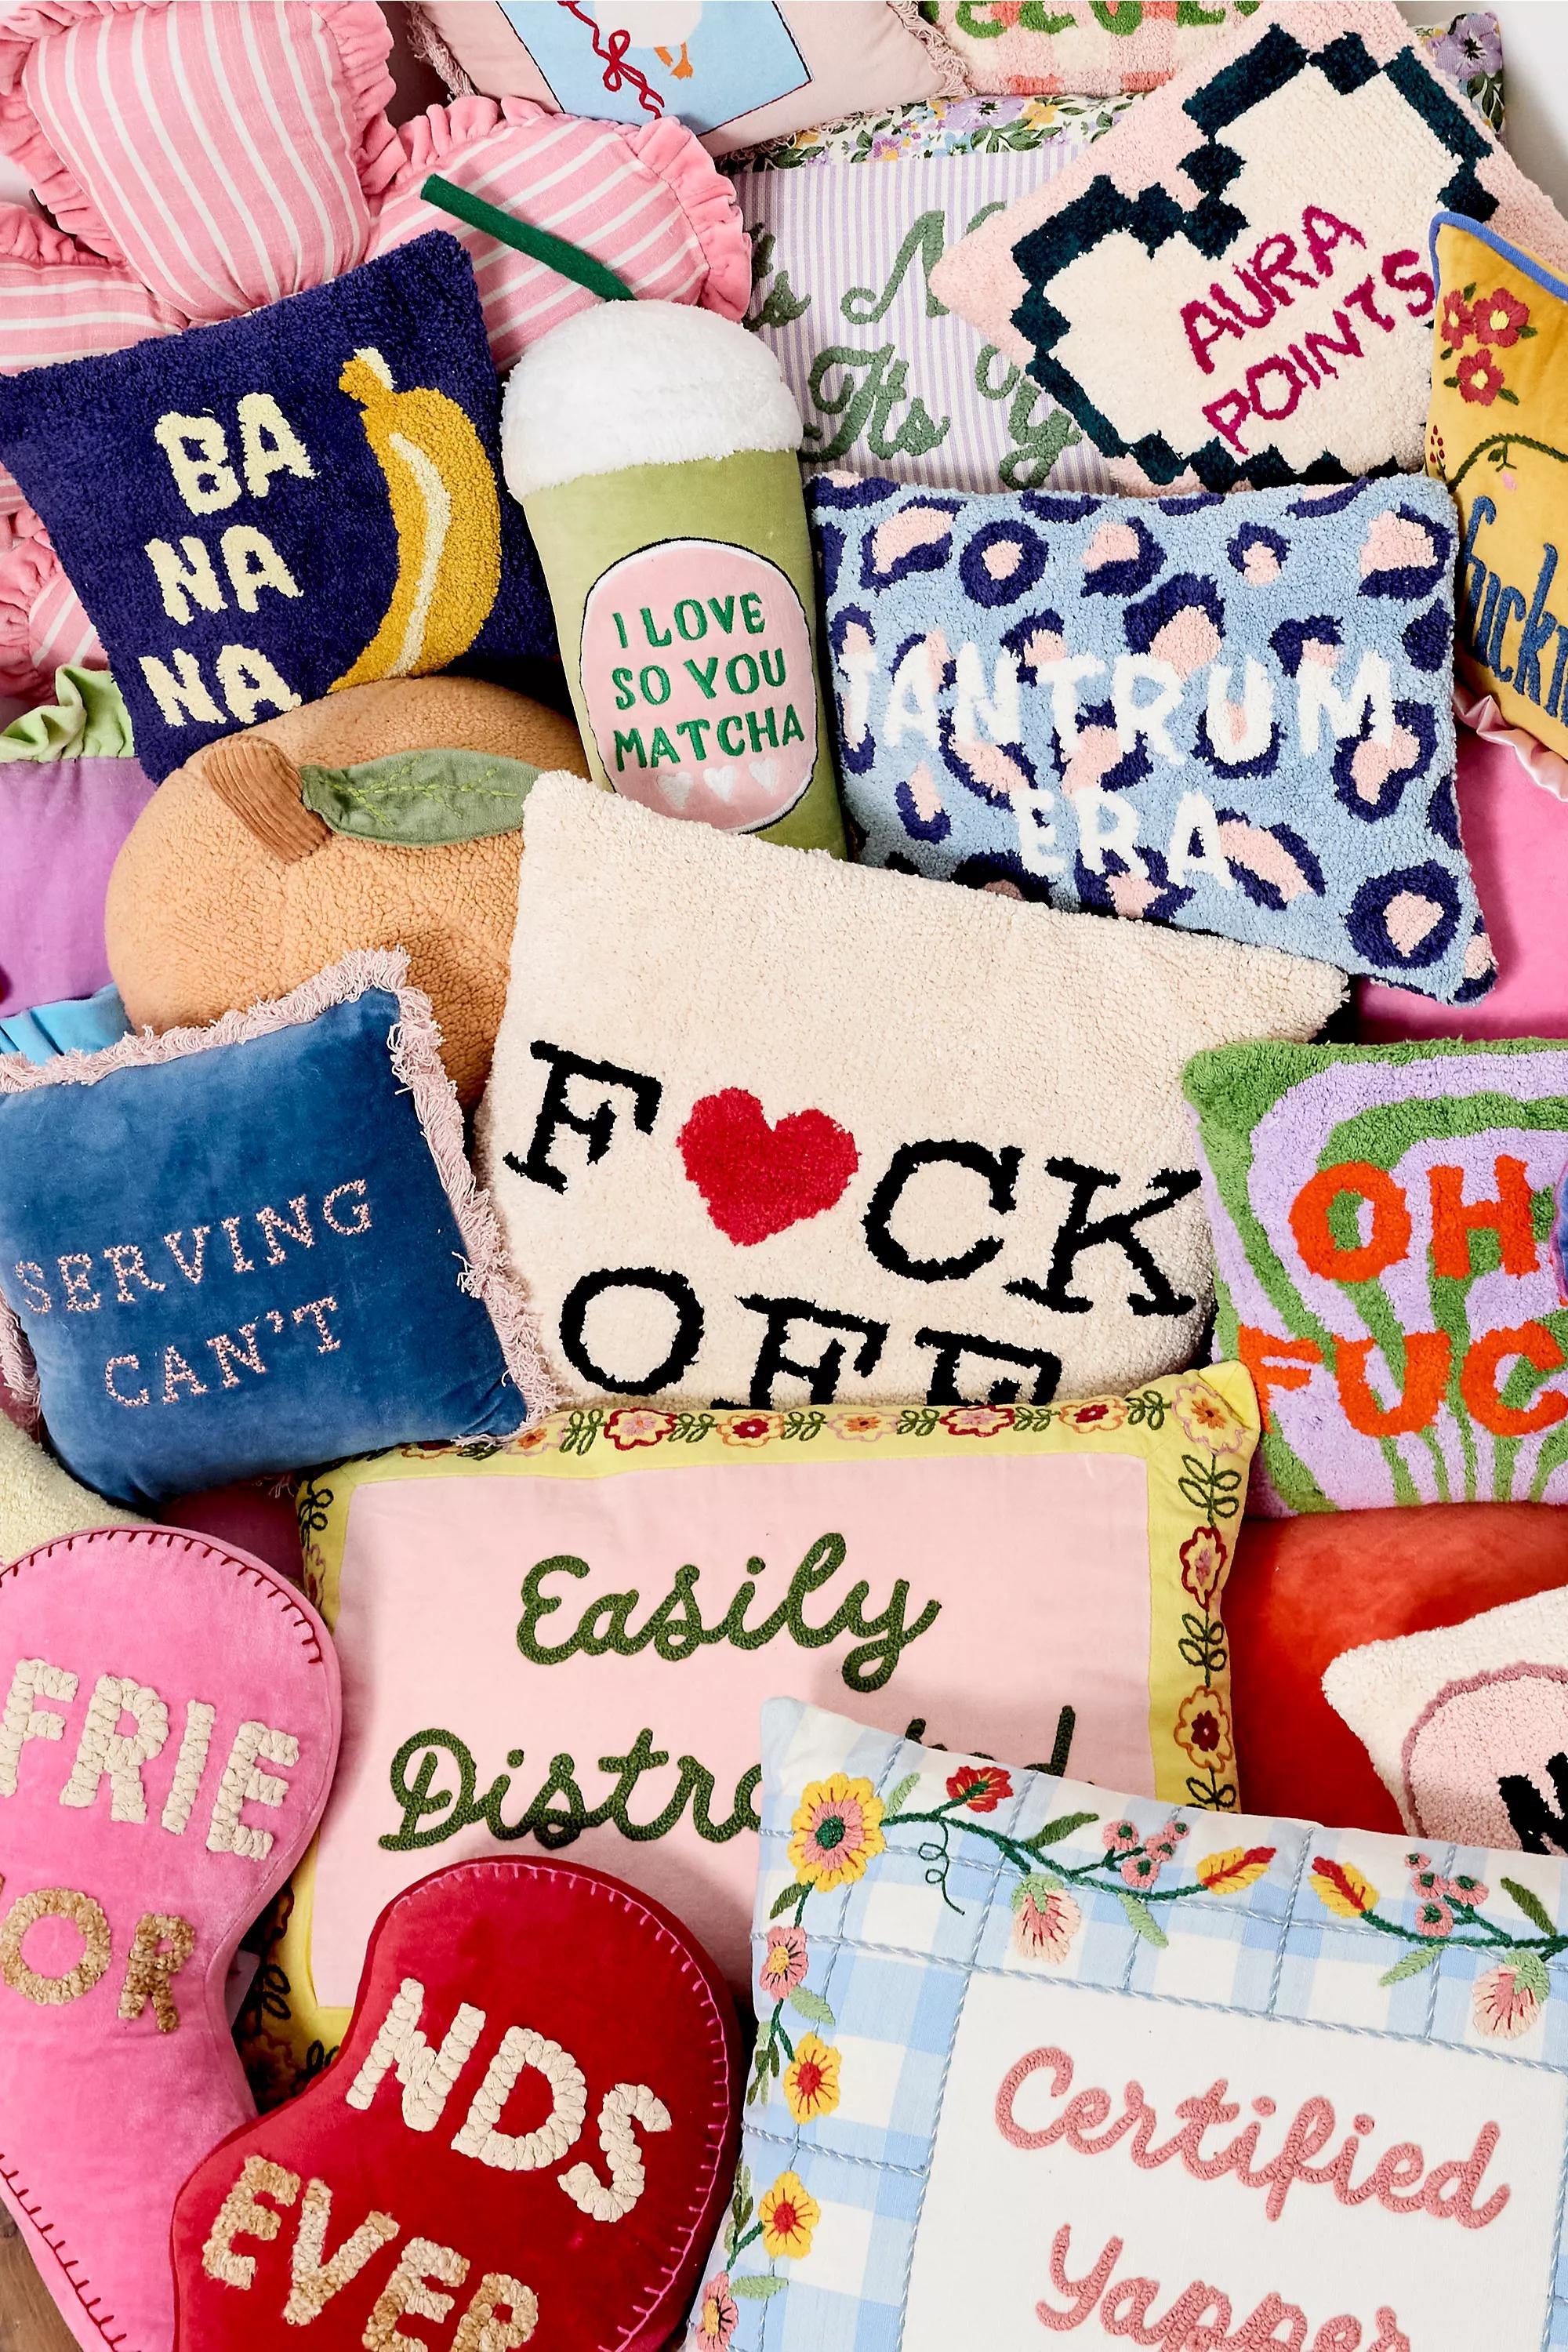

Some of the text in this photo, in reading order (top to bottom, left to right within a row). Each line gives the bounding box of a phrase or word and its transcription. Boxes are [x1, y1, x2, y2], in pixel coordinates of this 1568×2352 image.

[1179, 205, 1367, 376] AURA
[1201, 249, 1435, 456] POINTS
[153, 391, 318, 517] BA
[143, 524, 304, 626] NA
[612, 590, 767, 650] I LOVE
[138, 644, 303, 728] NA
[611, 648, 786, 712] SO YOU
[612, 702, 806, 773] MATCHA
[836, 641, 1401, 768] TANTRUM
[1016, 787, 1237, 892] ERA
[13, 1178, 374, 1316] SERVING
[1288, 1154, 1541, 1283] OH
[103, 1295, 342, 1409] CAN'T
[517, 1532, 942, 1693] Easily
[0, 1657, 300, 1862] FRIE
[0, 1872, 195, 2034] OR
[345, 1976, 673, 2223] NDS
[994, 2045, 1512, 2230] Certified
